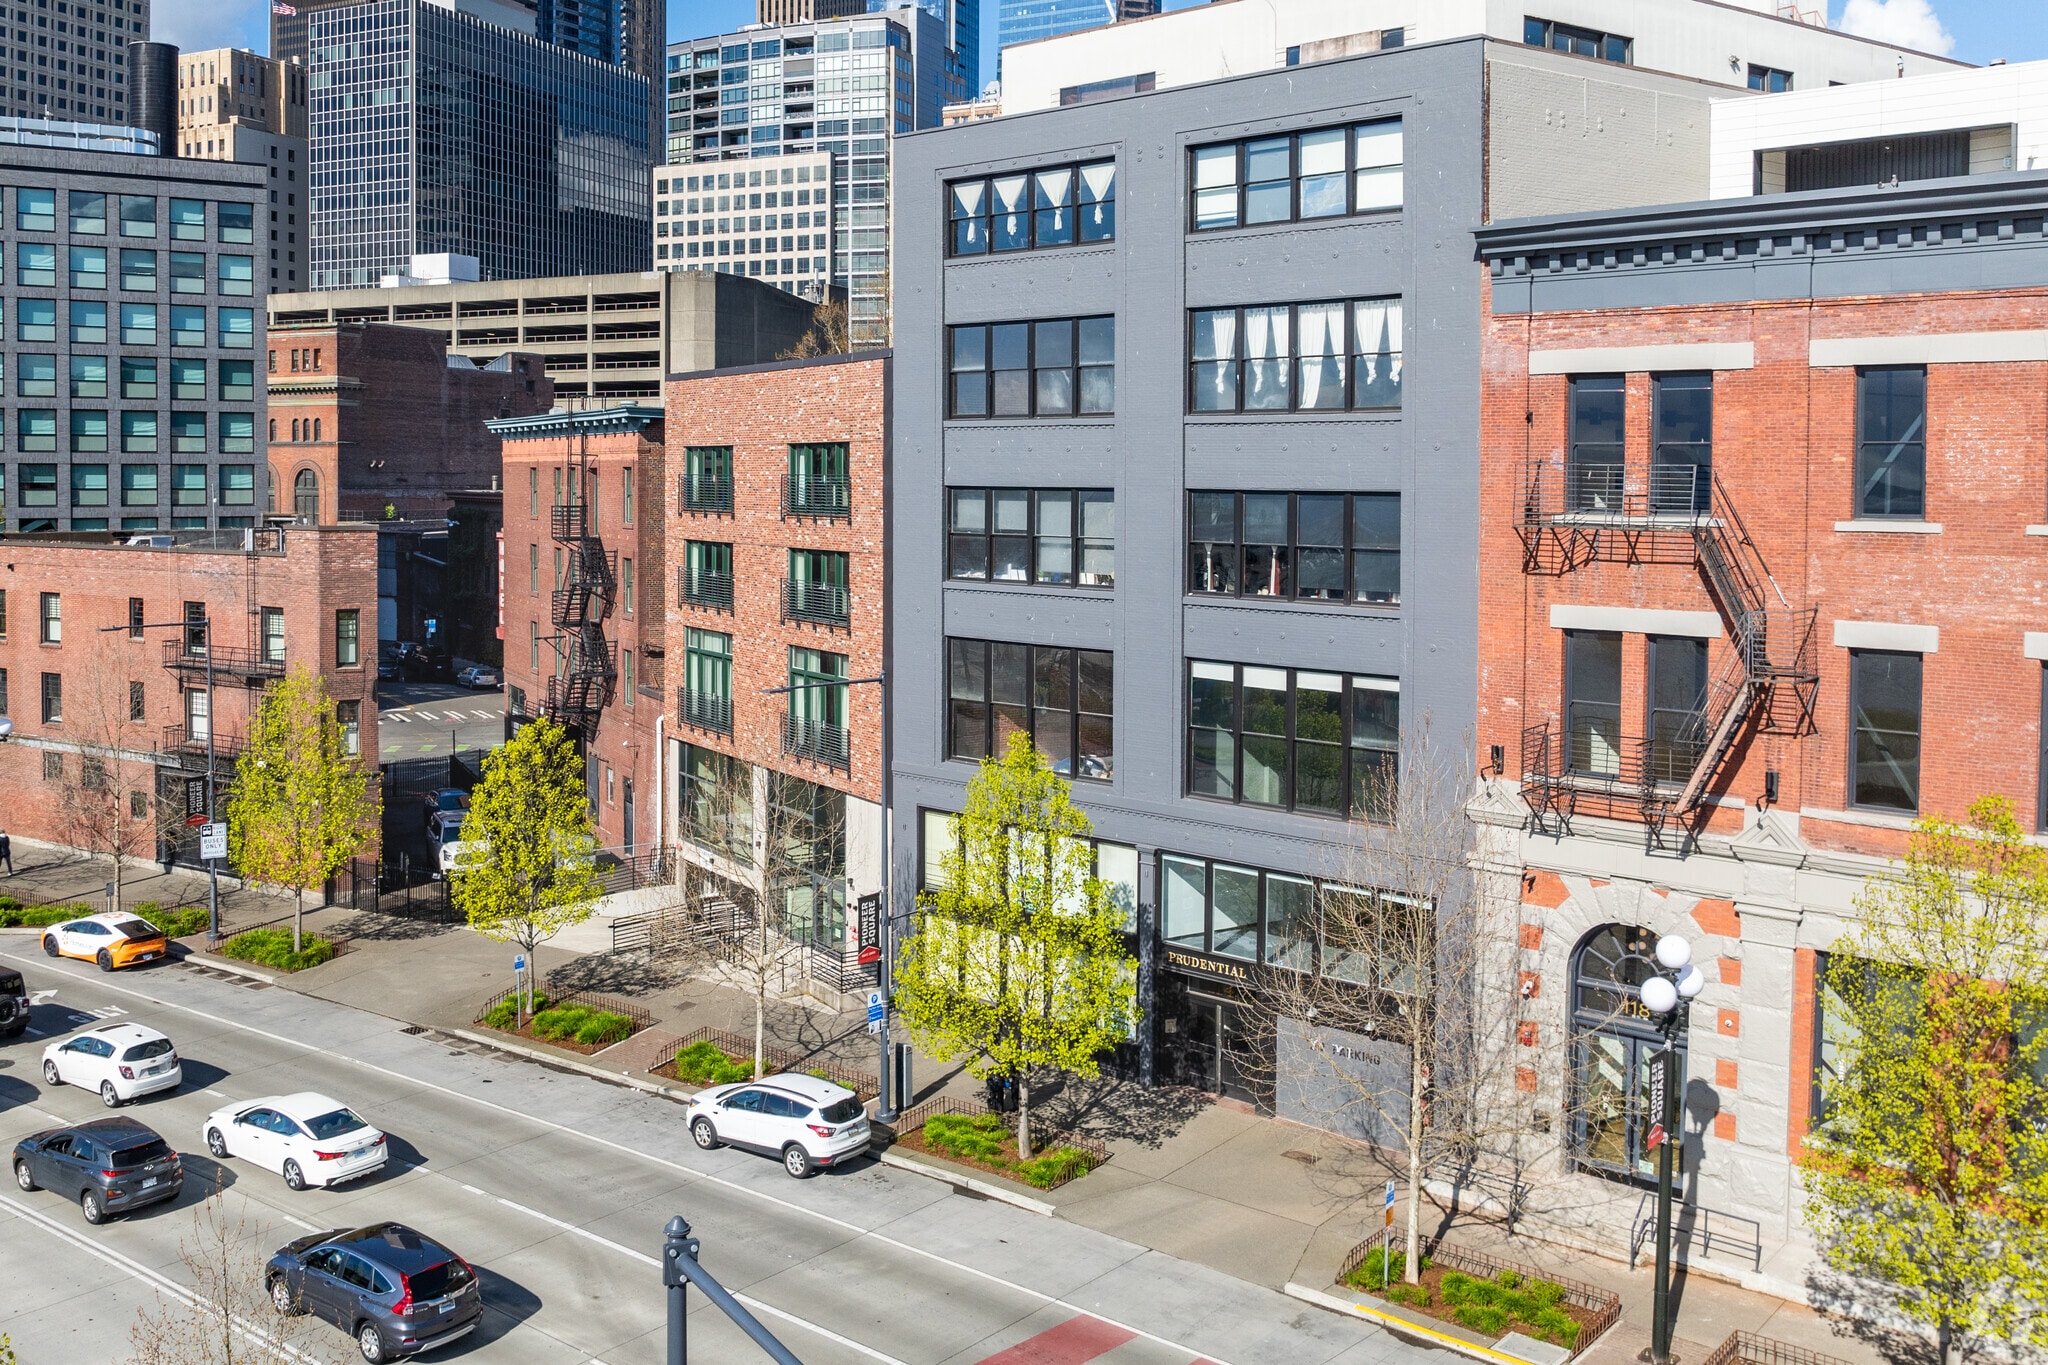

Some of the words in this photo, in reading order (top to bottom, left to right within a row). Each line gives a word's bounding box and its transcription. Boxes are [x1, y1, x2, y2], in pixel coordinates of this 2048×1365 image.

[861, 901, 869, 947] PIONEER
[868, 899, 876, 945] SQUARE
[1168, 951, 1247, 979] PRUDENTIAL
[67, 1005, 129, 1023] ONLY
[1624, 1000, 1651, 1018] 118
[1331, 1043, 1381, 1066] PARKING
[1650, 1063, 1658, 1124] PIONEER
[1656, 1059, 1664, 1121] SQUARE
